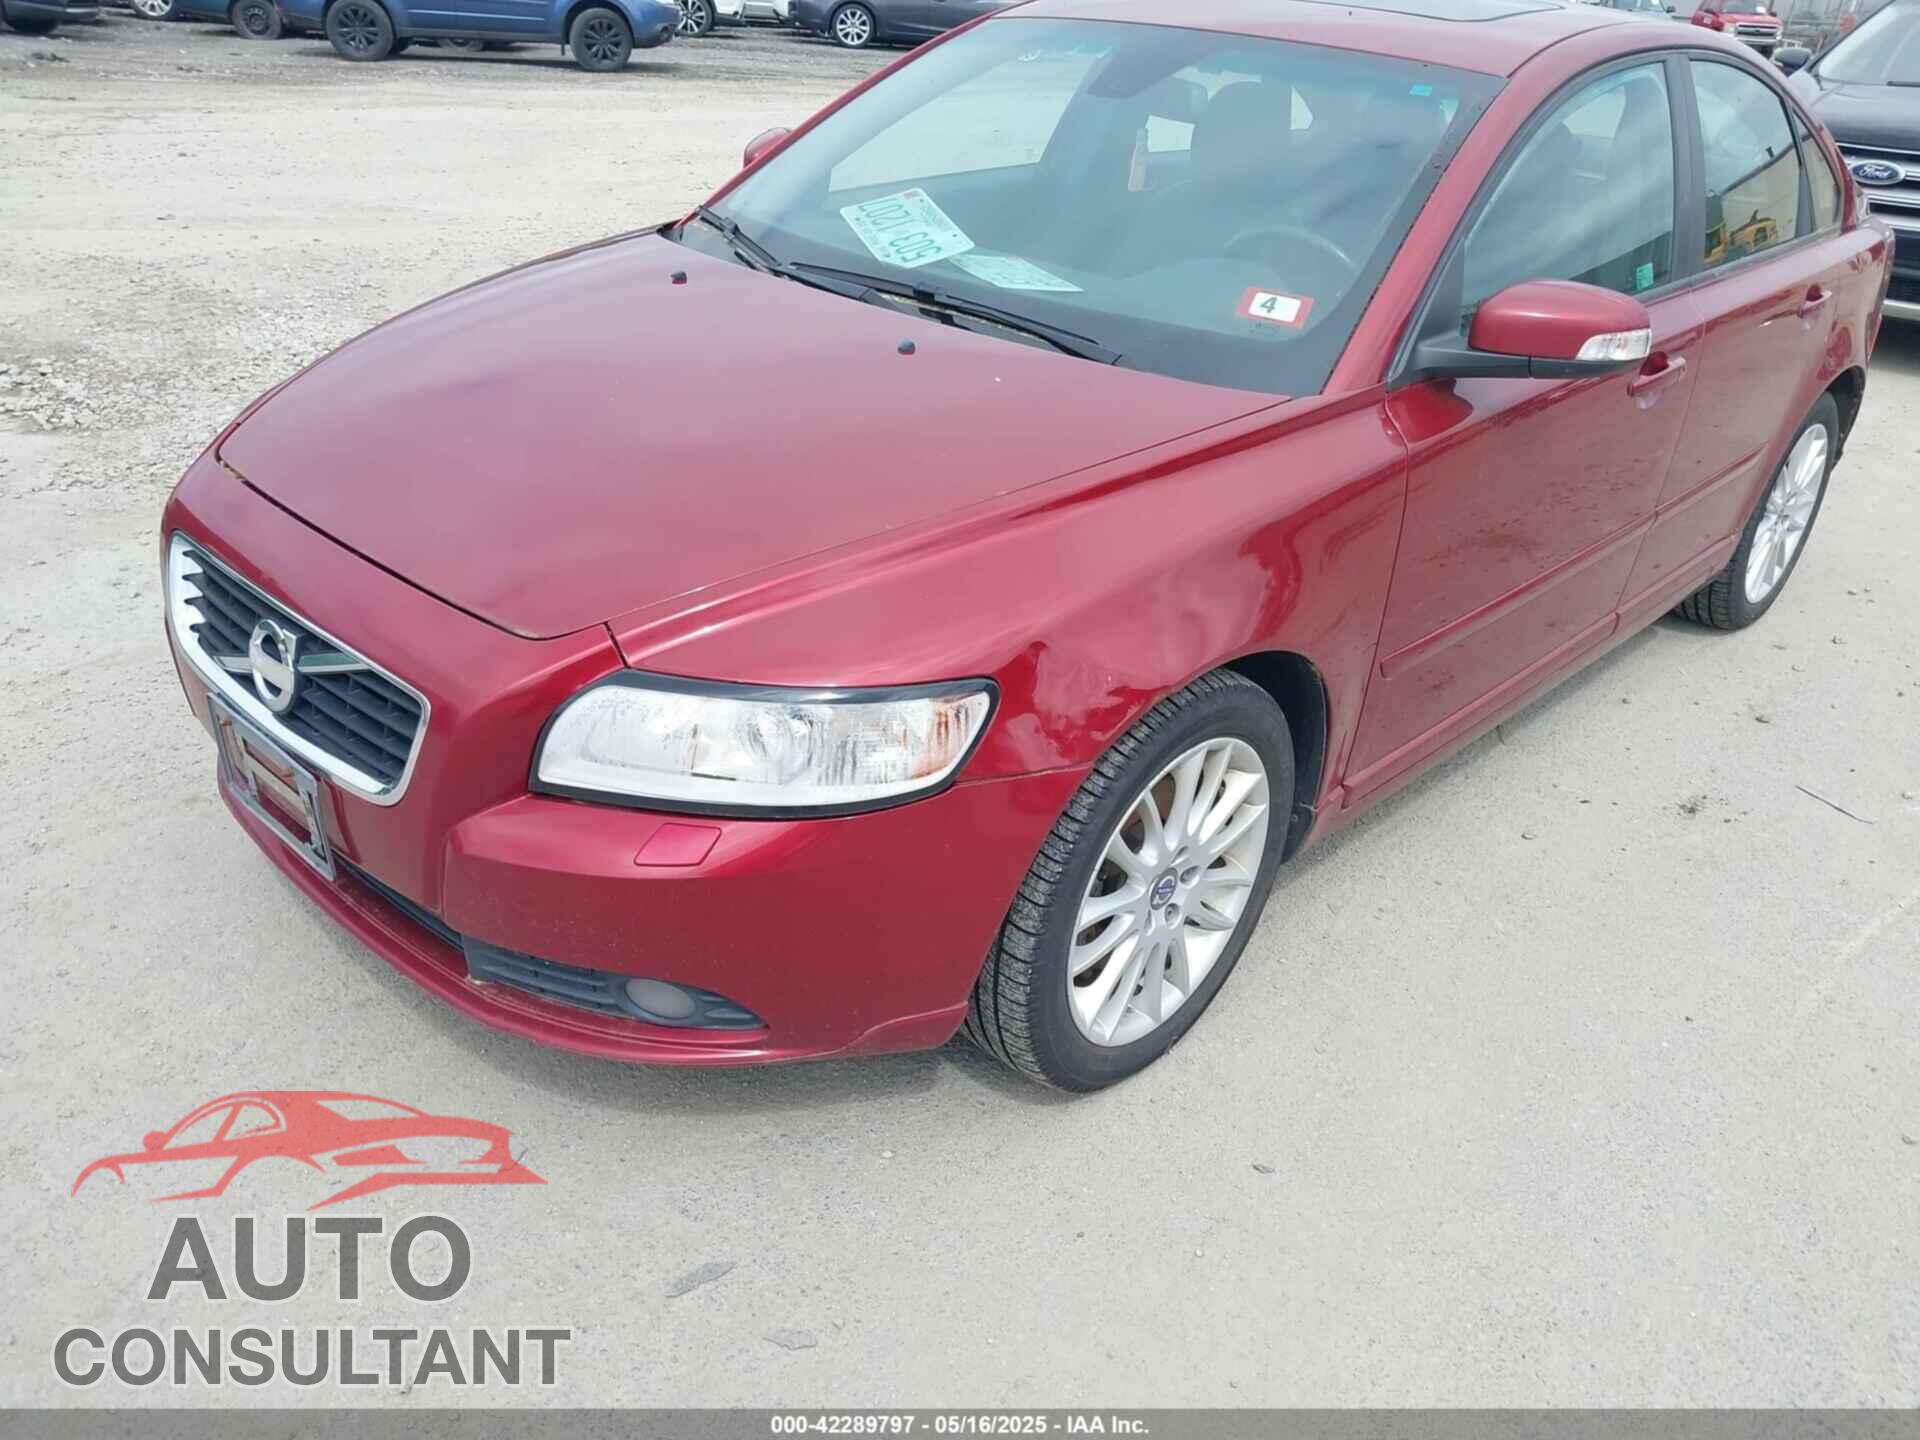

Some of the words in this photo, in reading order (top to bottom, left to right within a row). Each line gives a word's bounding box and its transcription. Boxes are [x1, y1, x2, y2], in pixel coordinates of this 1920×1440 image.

[1858, 164, 1892, 179] Ford
[858, 197, 914, 231] 1207
[889, 232, 942, 263] 503
[1260, 296, 1278, 314] 4
